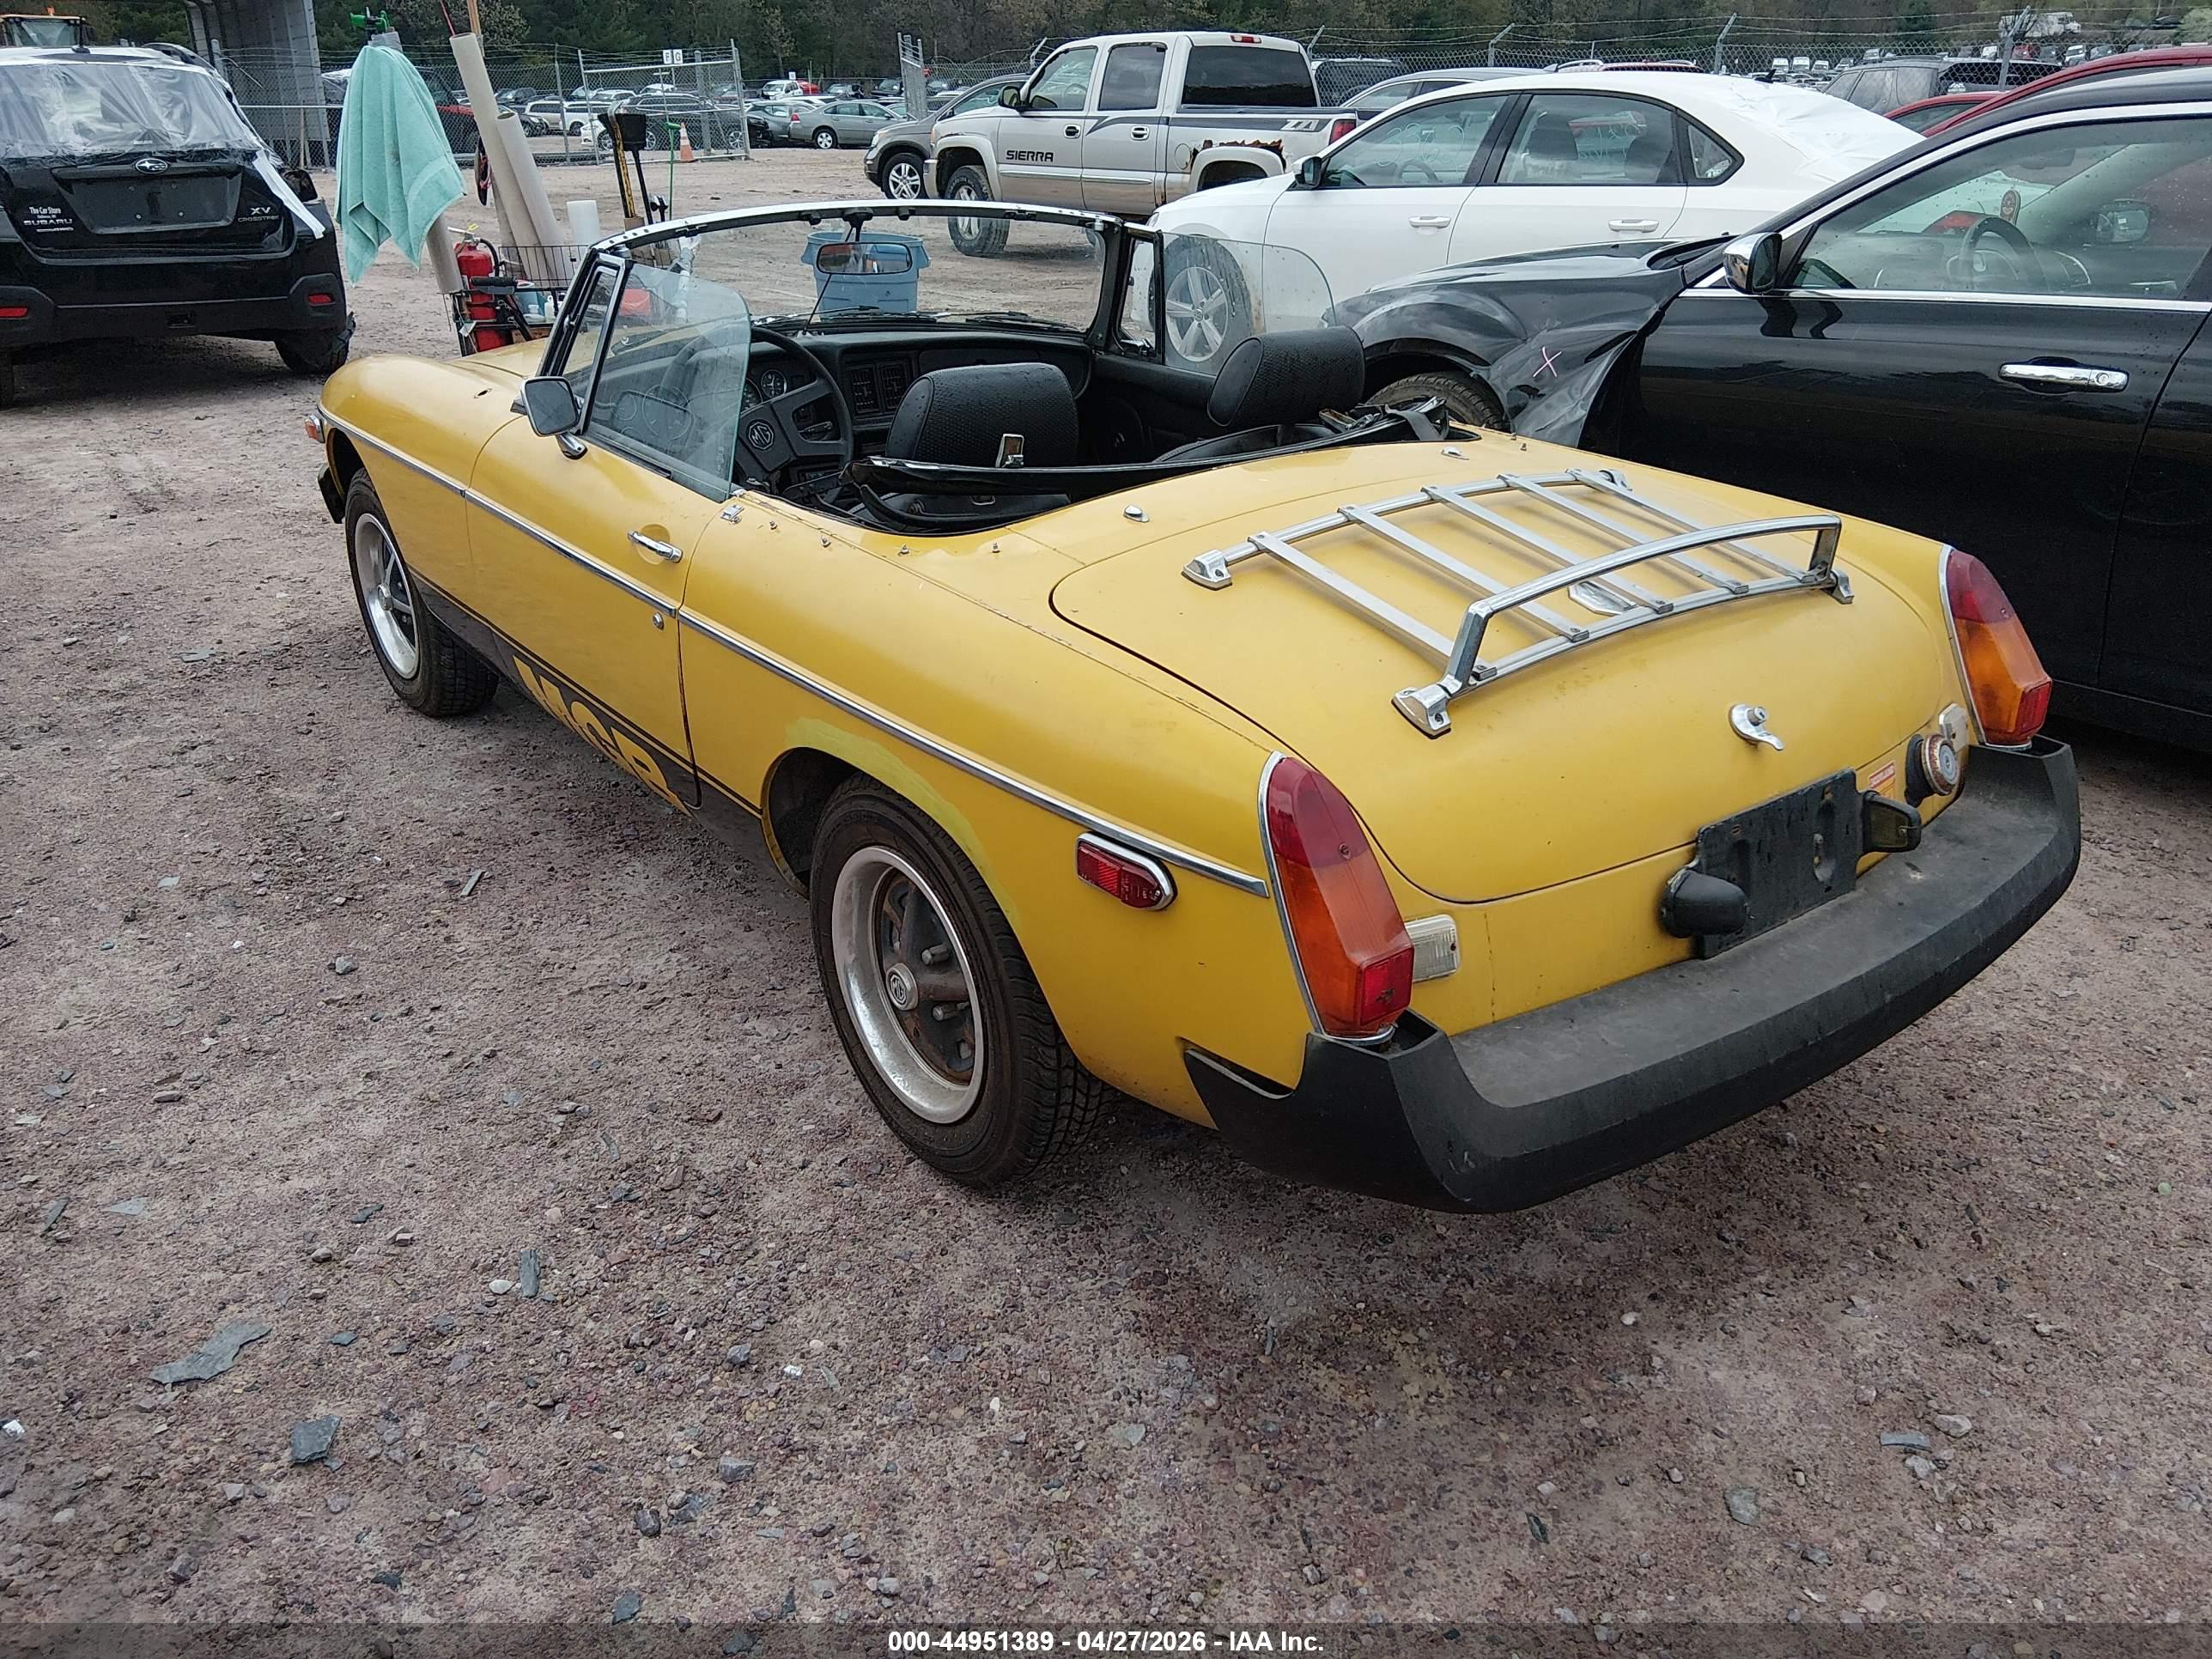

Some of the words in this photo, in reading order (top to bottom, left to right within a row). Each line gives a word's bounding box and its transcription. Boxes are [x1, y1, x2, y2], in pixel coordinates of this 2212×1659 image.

[1006, 149, 1054, 162] SIERRA
[250, 206, 270, 215] XV
[750, 424, 772, 446] MG
[891, 976, 906, 1000] MG
